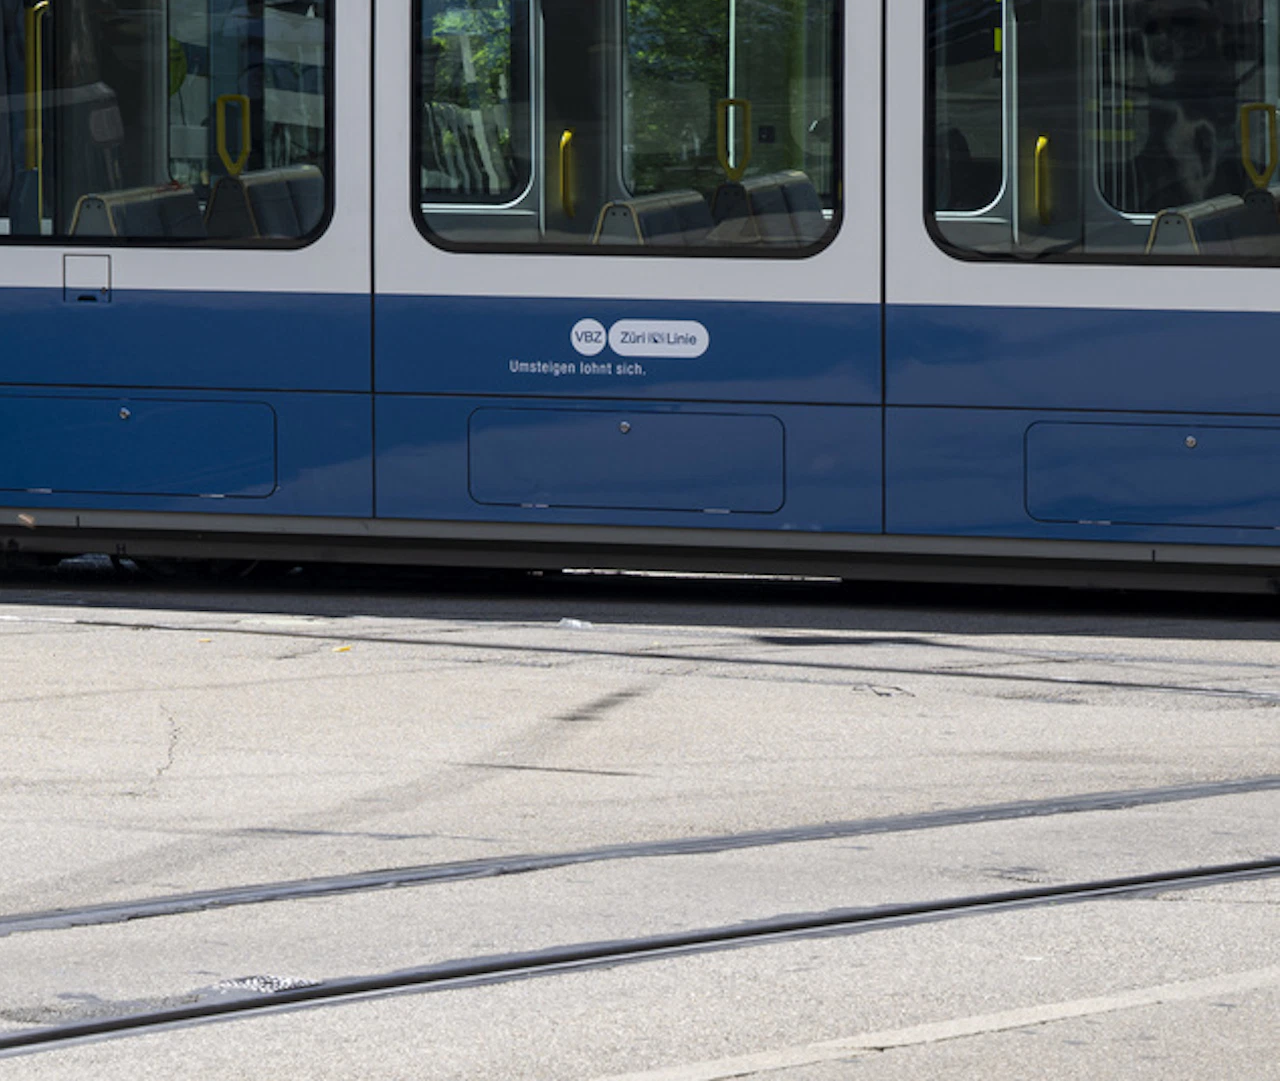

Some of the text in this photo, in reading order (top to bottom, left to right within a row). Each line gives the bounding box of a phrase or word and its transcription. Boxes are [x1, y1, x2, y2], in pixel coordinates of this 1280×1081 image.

[574, 330, 697, 345] VBZ Züri Linie
[509, 360, 646, 376] Umsteigen lohnt sich.
